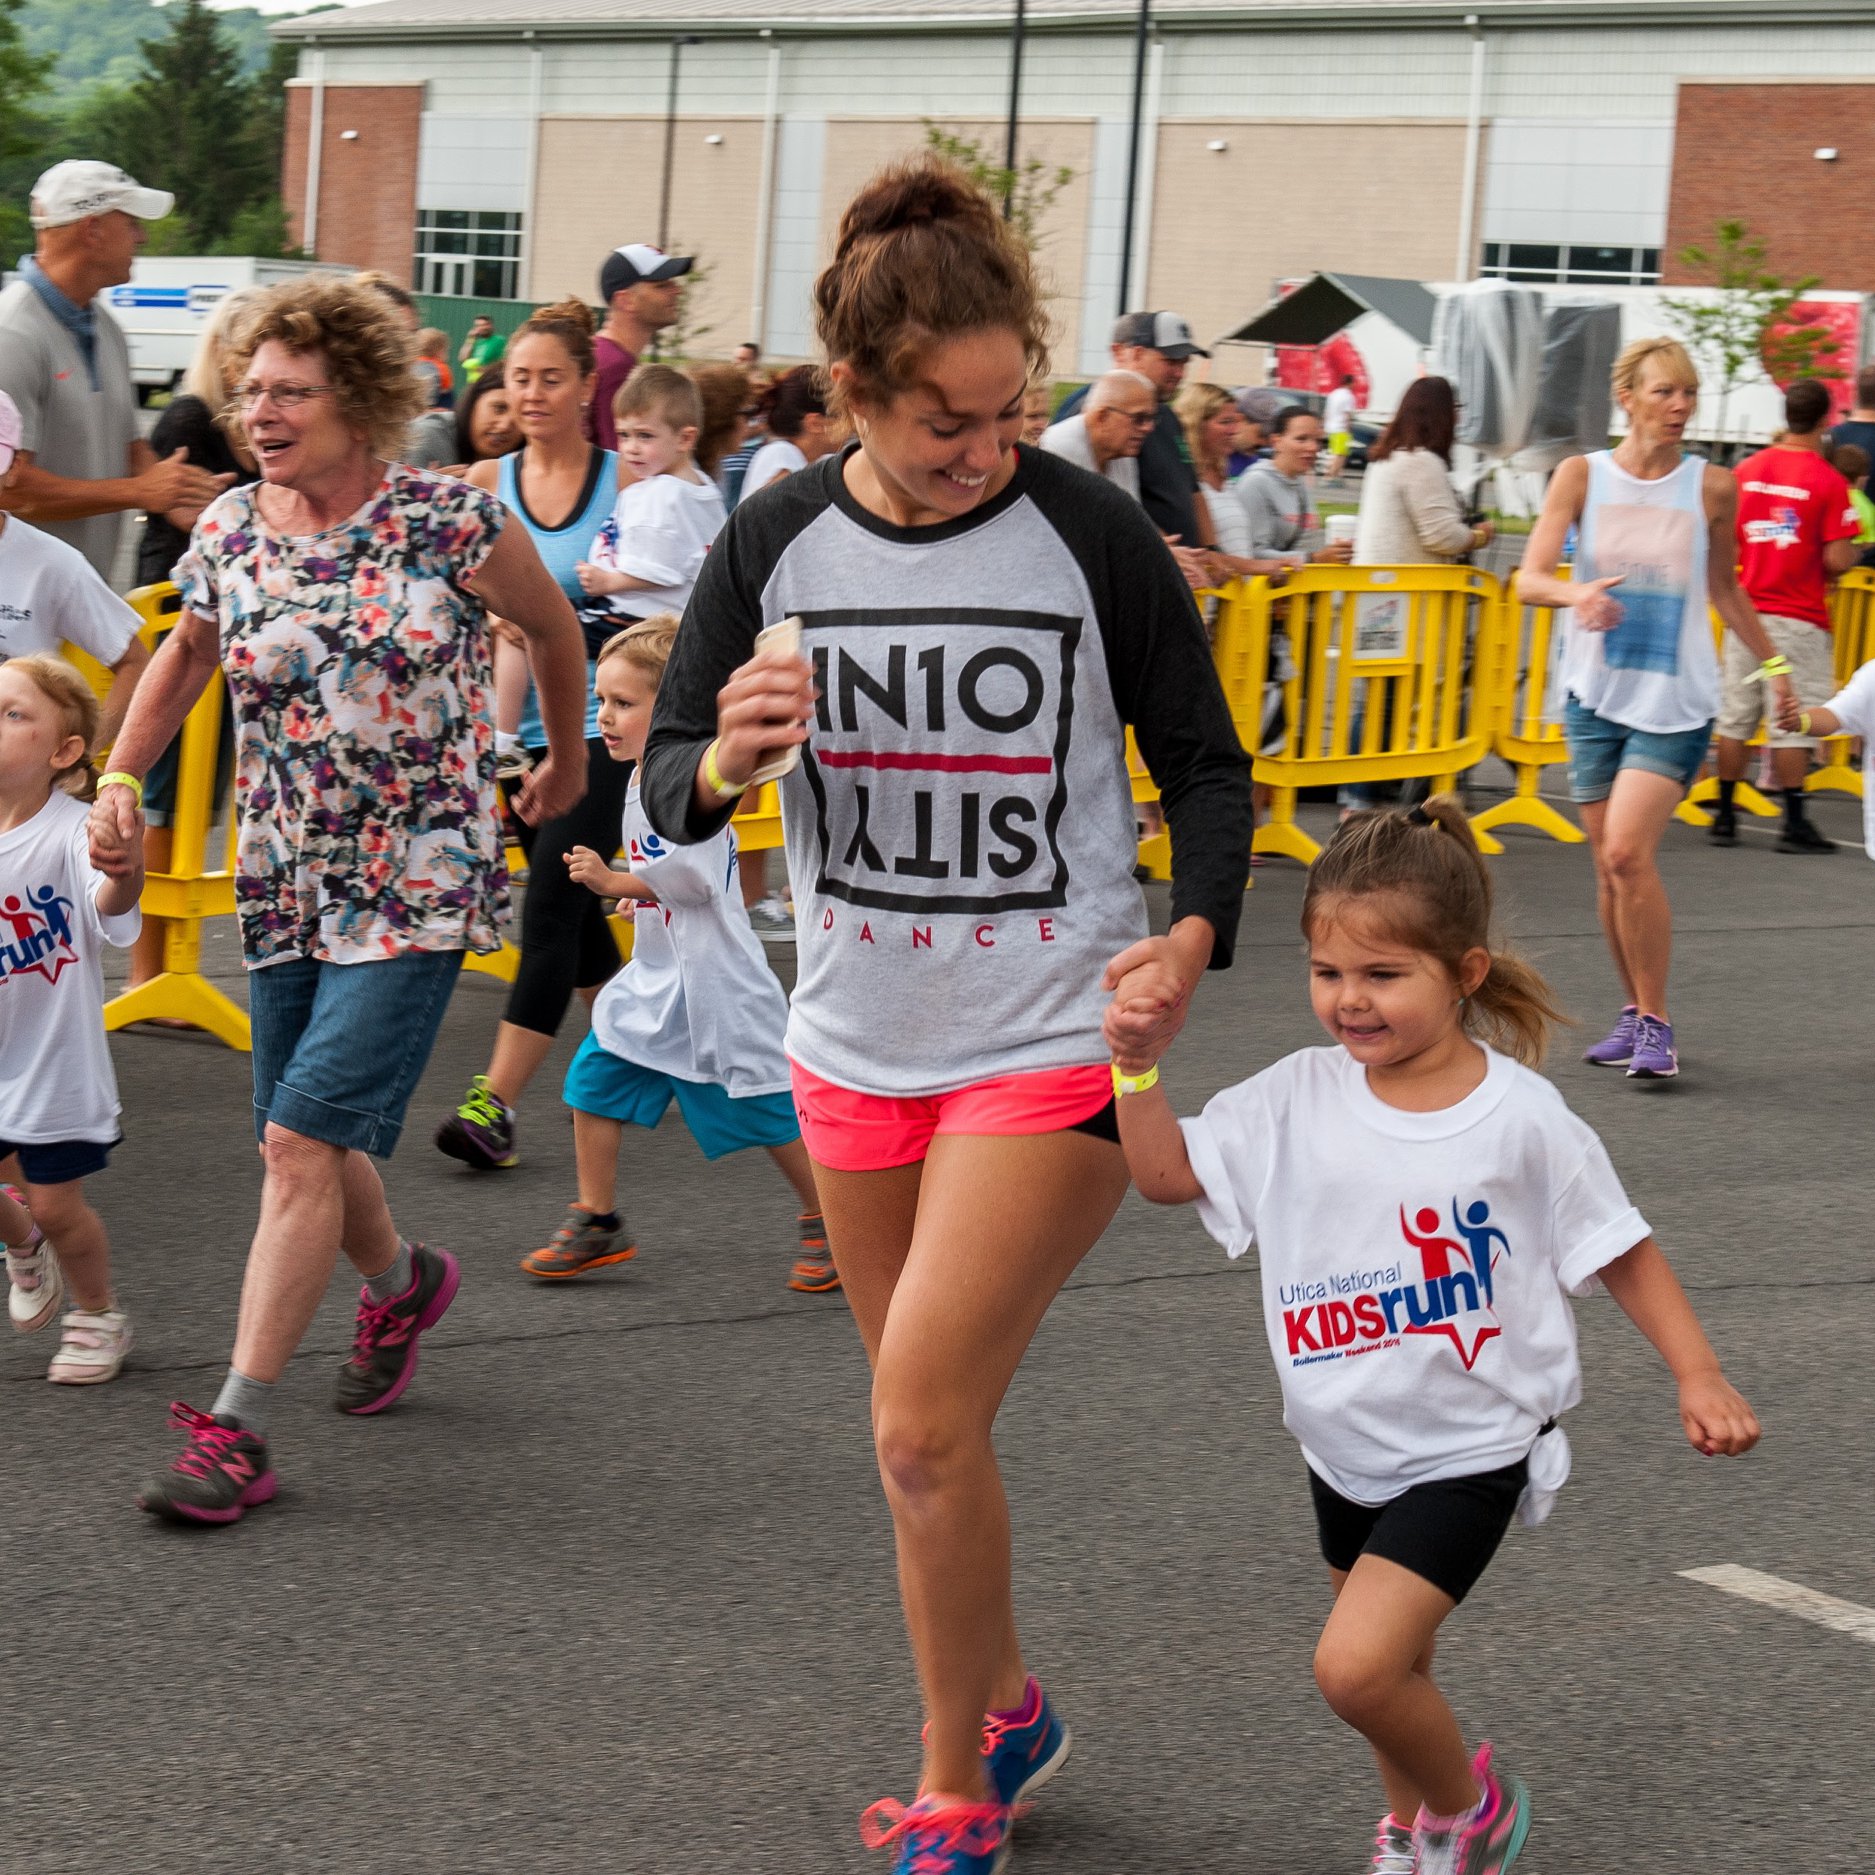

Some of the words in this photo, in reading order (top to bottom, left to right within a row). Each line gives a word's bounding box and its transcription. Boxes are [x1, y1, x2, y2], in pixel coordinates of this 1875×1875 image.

[823, 907, 1056, 949] DANCE
[1279, 1282, 1327, 1305] Utica
[1330, 1260, 1403, 1297] National
